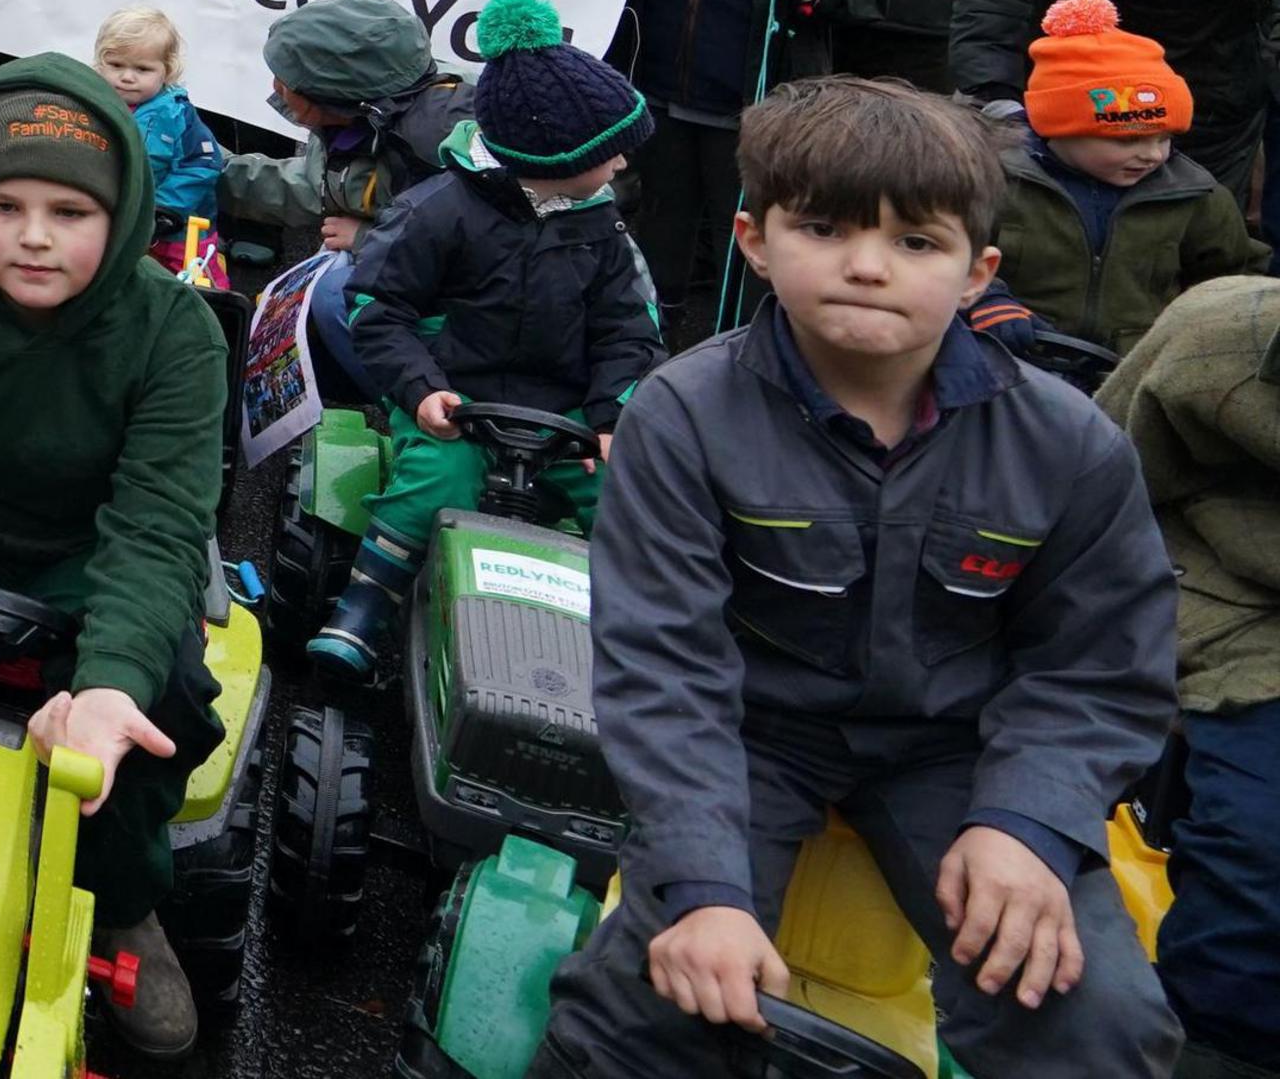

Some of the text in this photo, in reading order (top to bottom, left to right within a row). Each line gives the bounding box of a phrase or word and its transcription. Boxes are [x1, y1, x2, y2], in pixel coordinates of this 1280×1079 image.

[33, 104, 90, 126] #Save
[1095, 107, 1168, 123] PUMPKINS
[8, 121, 109, 152] FamilyFarms
[480, 562, 591, 596] REDLYNCH
